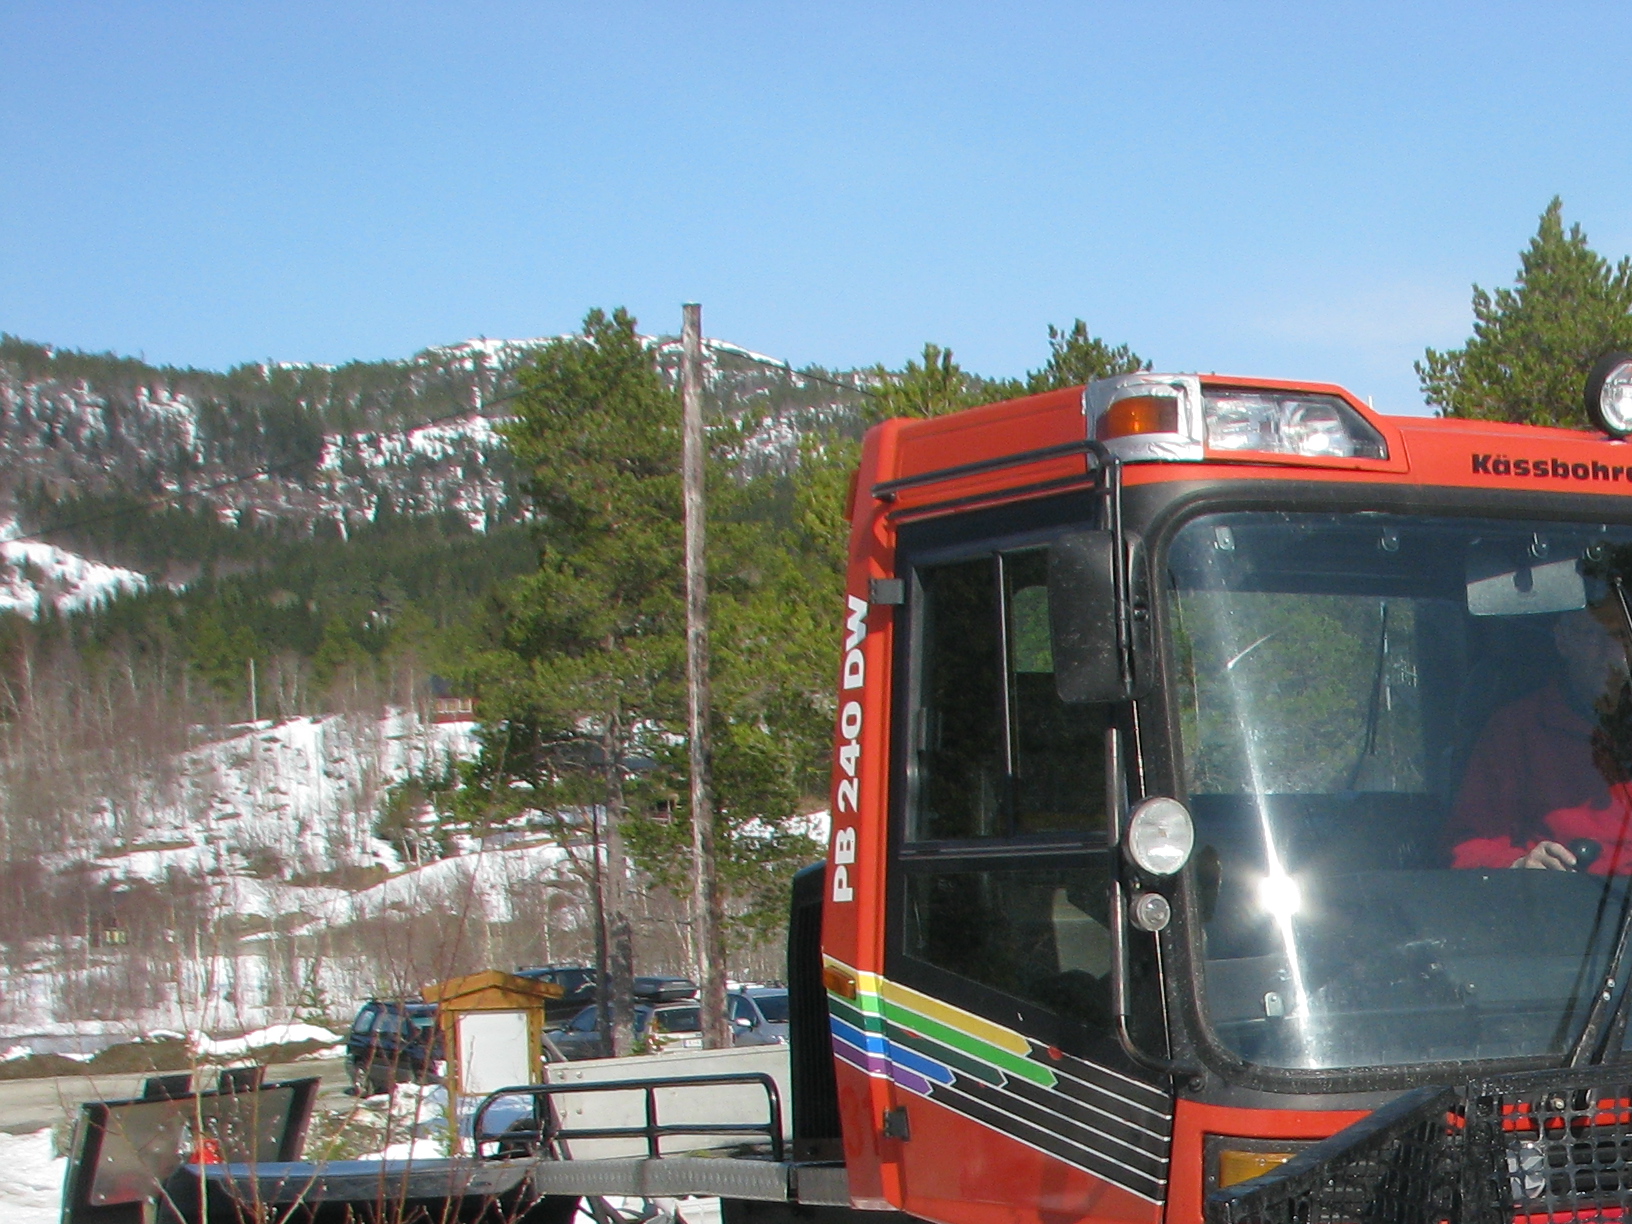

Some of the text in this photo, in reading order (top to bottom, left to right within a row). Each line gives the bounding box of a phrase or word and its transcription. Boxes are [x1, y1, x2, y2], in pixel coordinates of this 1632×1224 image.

[833, 594, 868, 902] PB 240 DW
